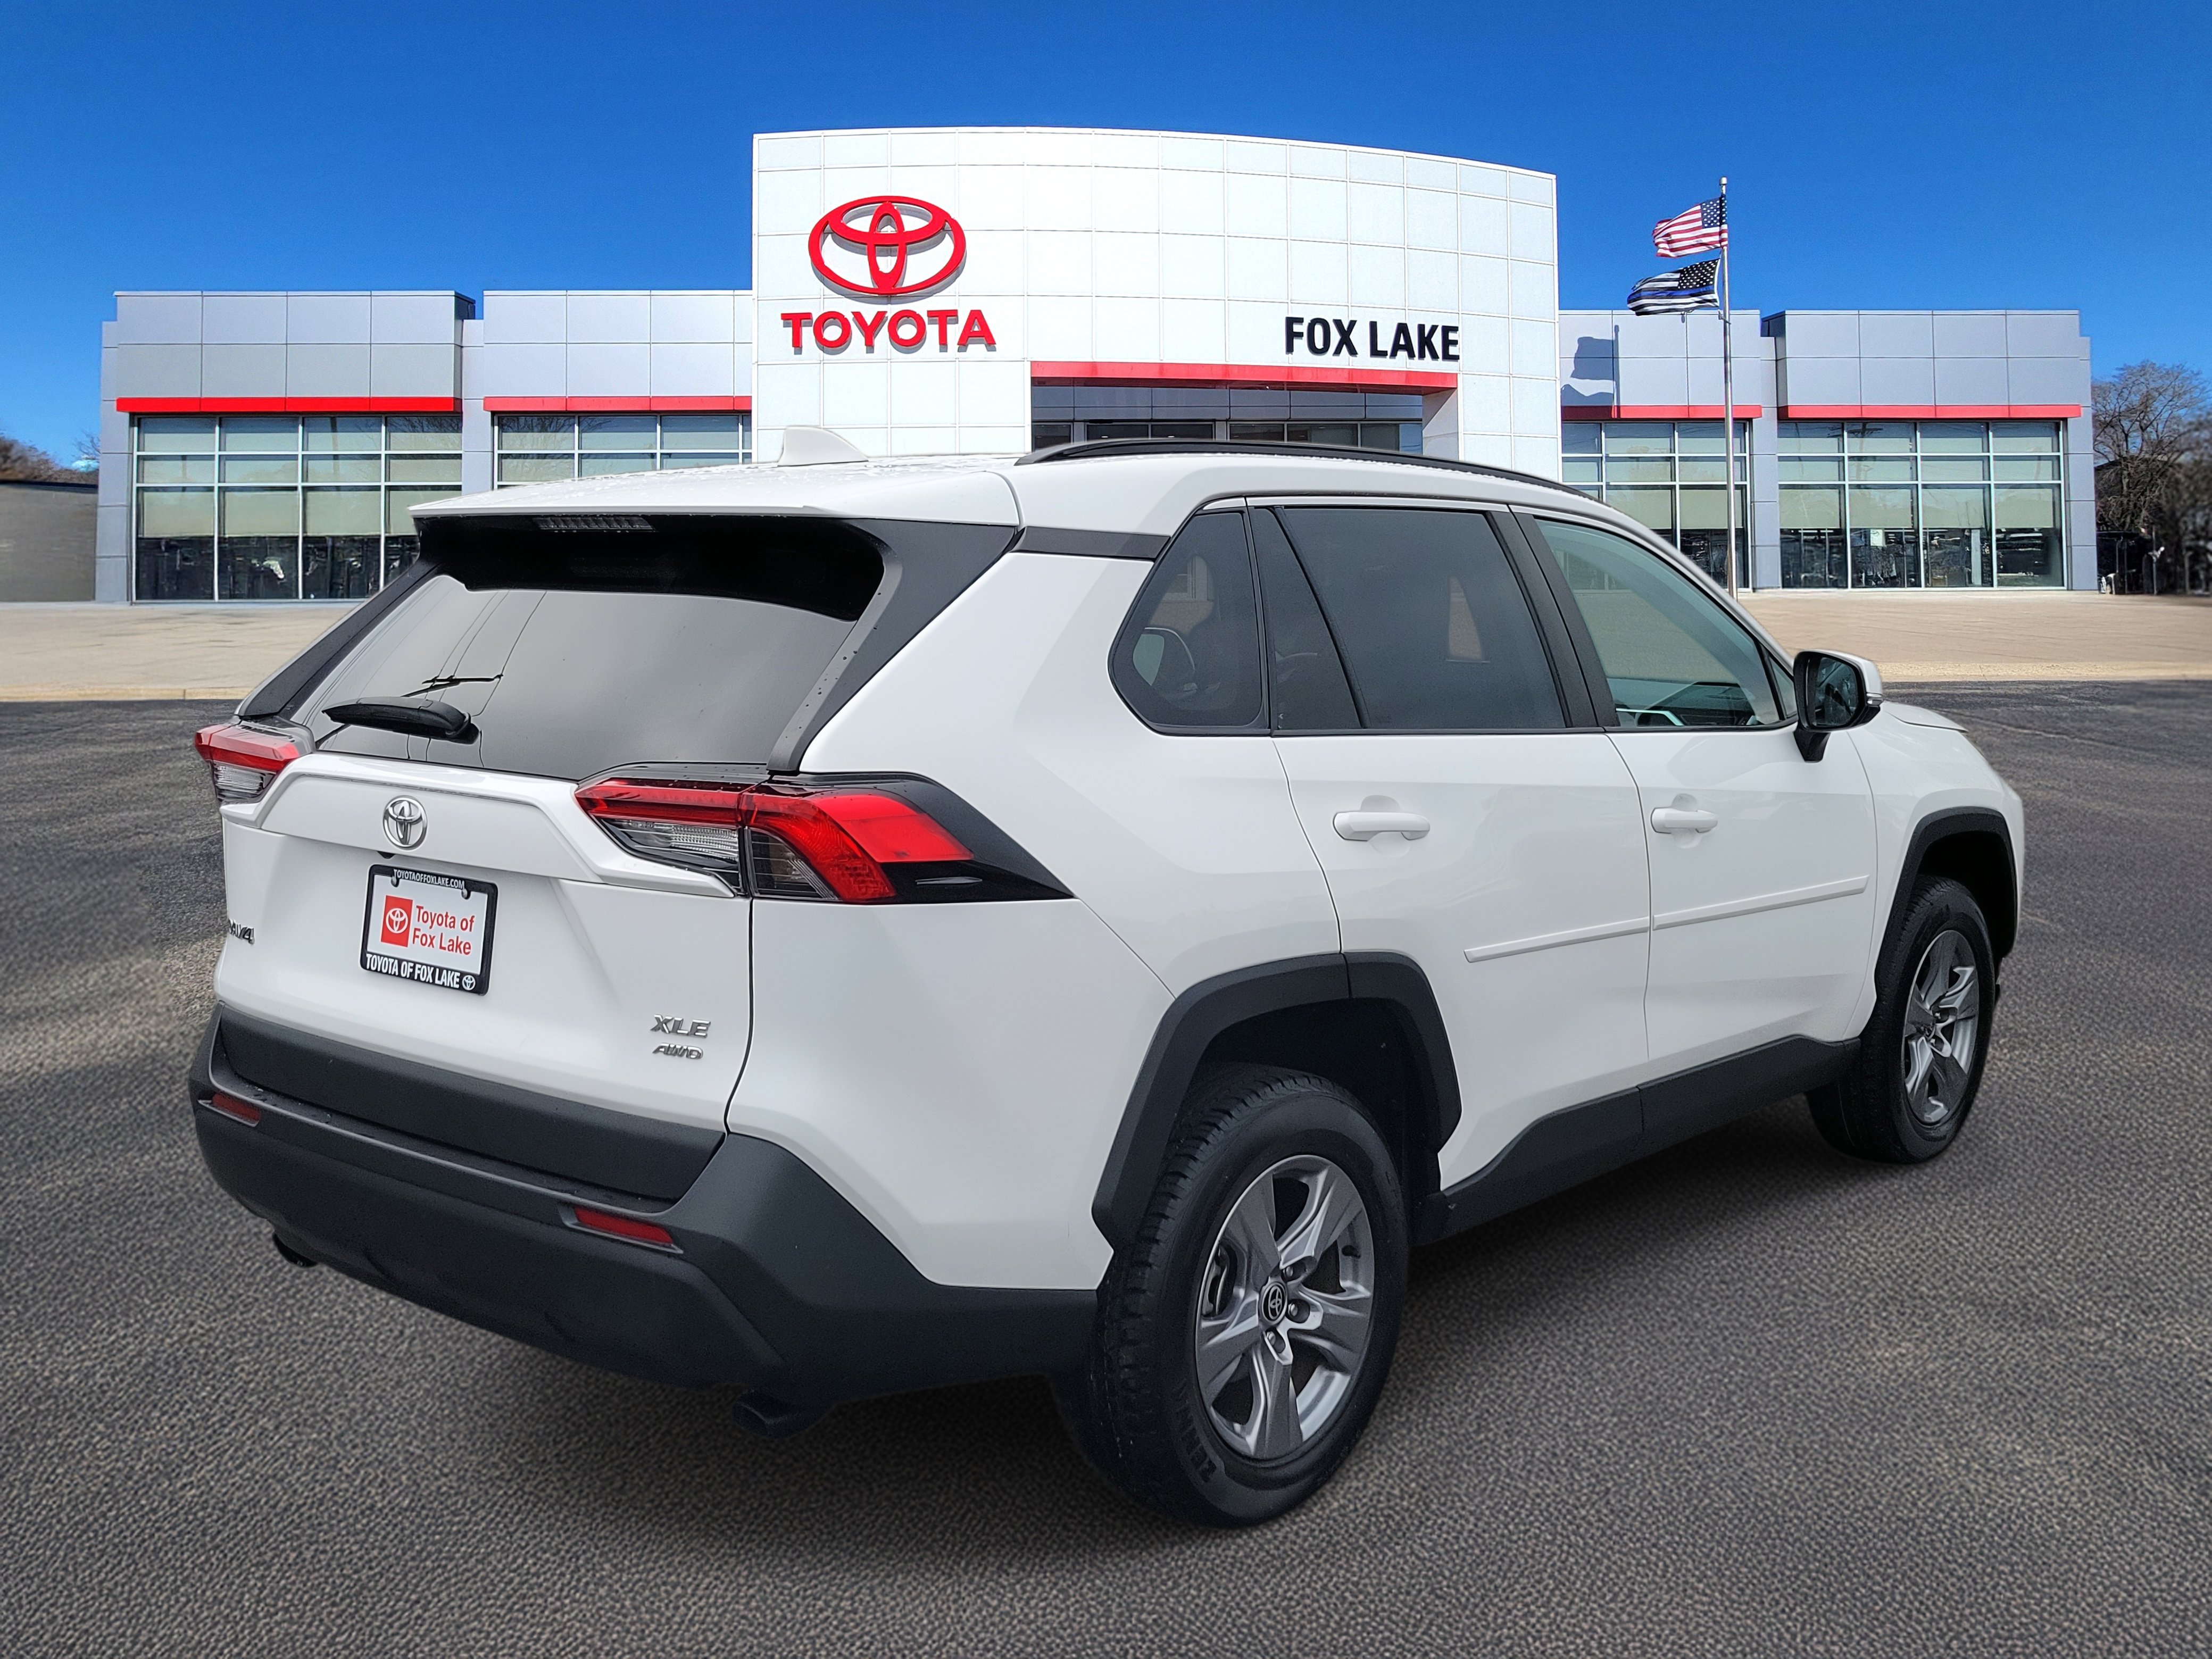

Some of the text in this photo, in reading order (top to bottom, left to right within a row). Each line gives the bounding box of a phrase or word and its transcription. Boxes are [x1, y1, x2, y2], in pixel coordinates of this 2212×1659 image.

[780, 309, 996, 349] TOYOTA
[1285, 316, 1460, 361] FOX LAKE
[393, 869, 465, 889] TOYOTAOFFOXLAKE.COM
[415, 905, 475, 932] Toyota of
[412, 928, 471, 955] Fox Lake
[366, 954, 461, 989] TOYOTA OF FOX LAKE
[650, 1014, 711, 1038] XLE
[652, 1043, 704, 1060] AWD
